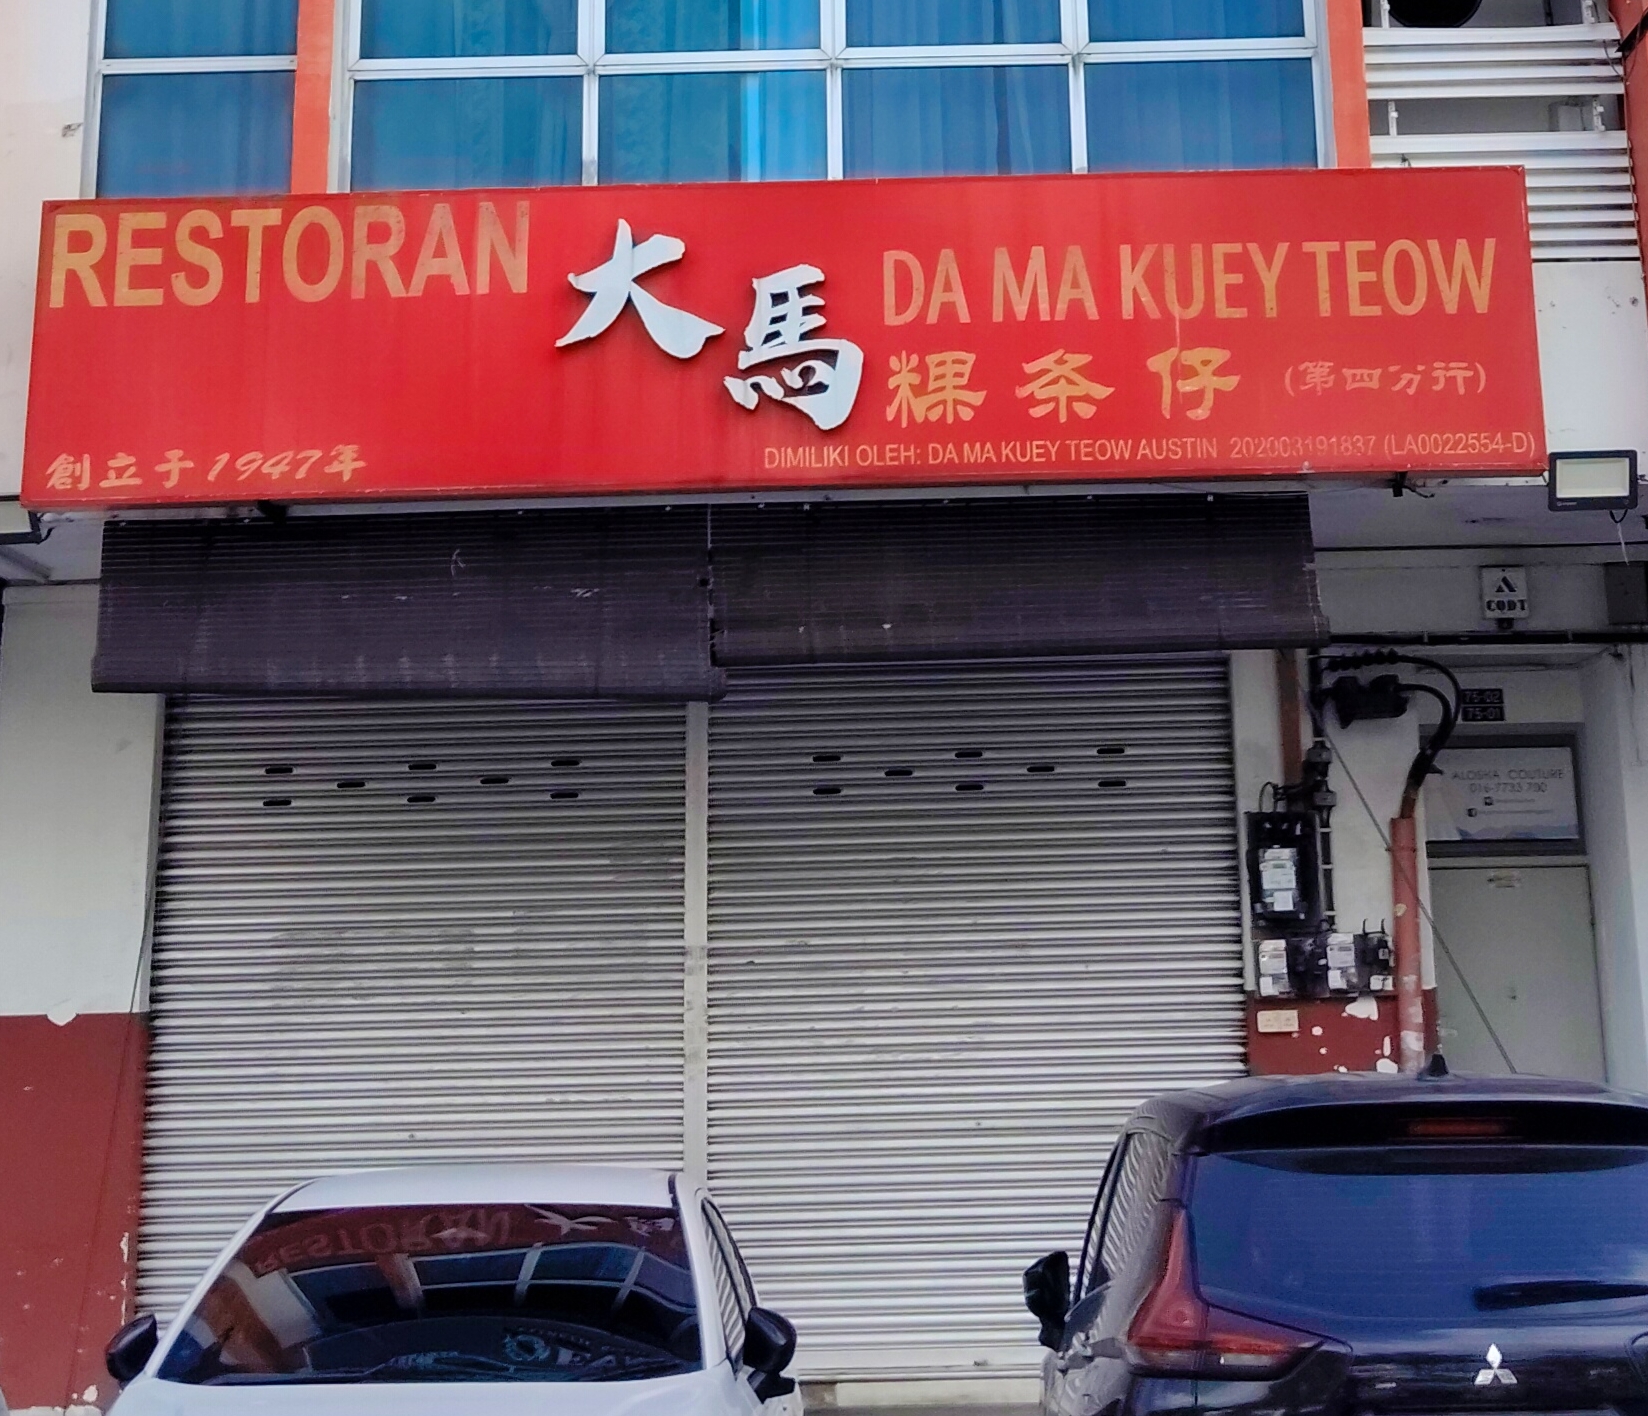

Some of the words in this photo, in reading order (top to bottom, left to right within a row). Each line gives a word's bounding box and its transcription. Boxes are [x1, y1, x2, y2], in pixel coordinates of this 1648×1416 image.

[48, 200, 530, 309] RESTORAN
[882, 247, 972, 326] DA
[991, 244, 1101, 323] MA
[1118, 241, 1291, 320] KUEY
[1301, 237, 1497, 317] TEOW
[554, 217, 865, 432] 大馬
[885, 347, 1242, 429] 粿条仔
[764, 444, 849, 469] DIMILIKI
[856, 444, 922, 467] OLEH:
[928, 442, 959, 465] DA
[963, 441, 997, 464] MA
[1001, 440, 1061, 463] KUEY
[1065, 438, 1133, 462] TEOW
[1137, 437, 1218, 460] AUSTIN
[1384, 432, 1535, 462] (LA0022554-D)
